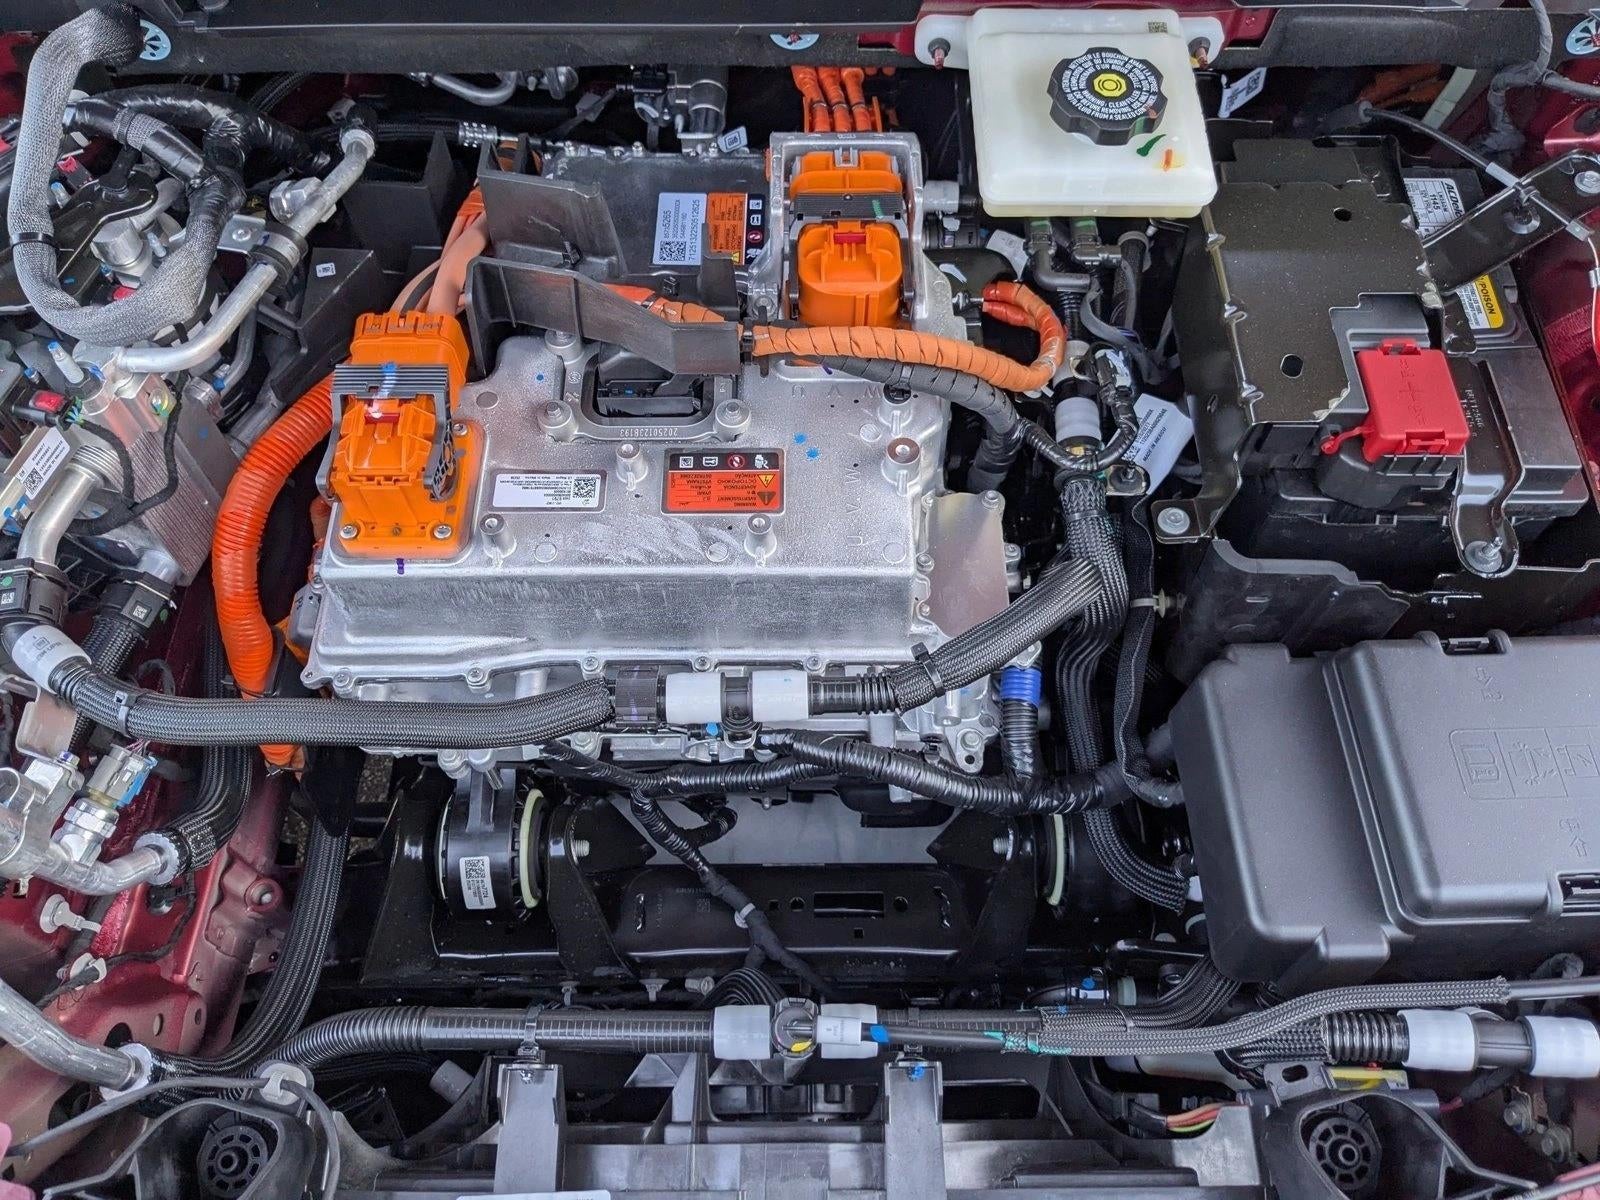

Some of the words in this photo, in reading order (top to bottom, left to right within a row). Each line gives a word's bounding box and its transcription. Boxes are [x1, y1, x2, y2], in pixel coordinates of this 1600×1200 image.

[1100, 52, 1129, 61] BOUCHON
[1127, 57, 1146, 70] AVANT
[1142, 68, 1152, 76] LA
[1073, 91, 1084, 100] CAP
[1078, 97, 1101, 111] BEFORE
[1108, 99, 1127, 107] CLEAN
[1130, 100, 1142, 109] USE
[1074, 102, 1092, 114] FLUID
[1089, 110, 1108, 119] FROM
[1113, 111, 1136, 120] SEALED
